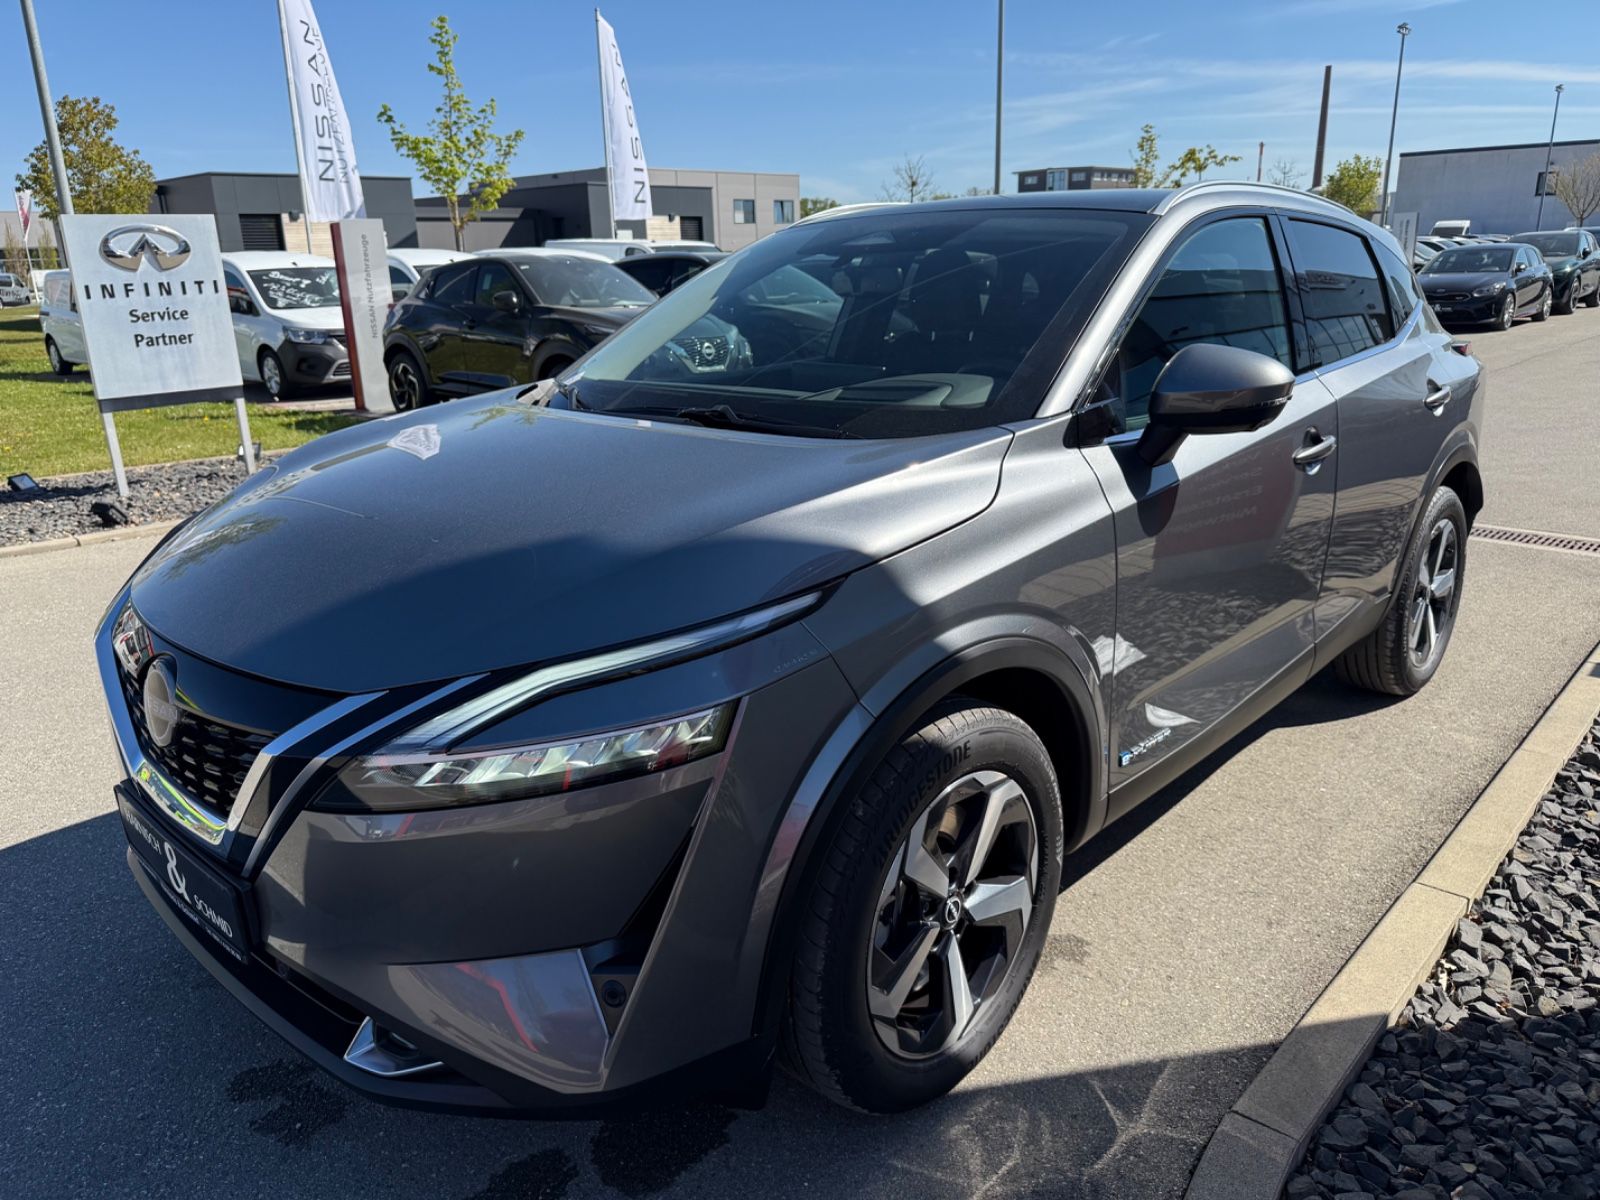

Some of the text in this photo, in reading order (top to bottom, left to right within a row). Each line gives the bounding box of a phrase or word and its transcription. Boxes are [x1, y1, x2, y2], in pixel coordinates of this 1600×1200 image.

[299, 19, 335, 183] NISSAN
[84, 279, 219, 300] INFINITI
[129, 307, 189, 323] Service
[361, 234, 378, 339] NISSAN Nutzfahrzeuge
[134, 332, 194, 348] Partner
[163, 841, 192, 905] &
[193, 894, 233, 938] SCHMID
